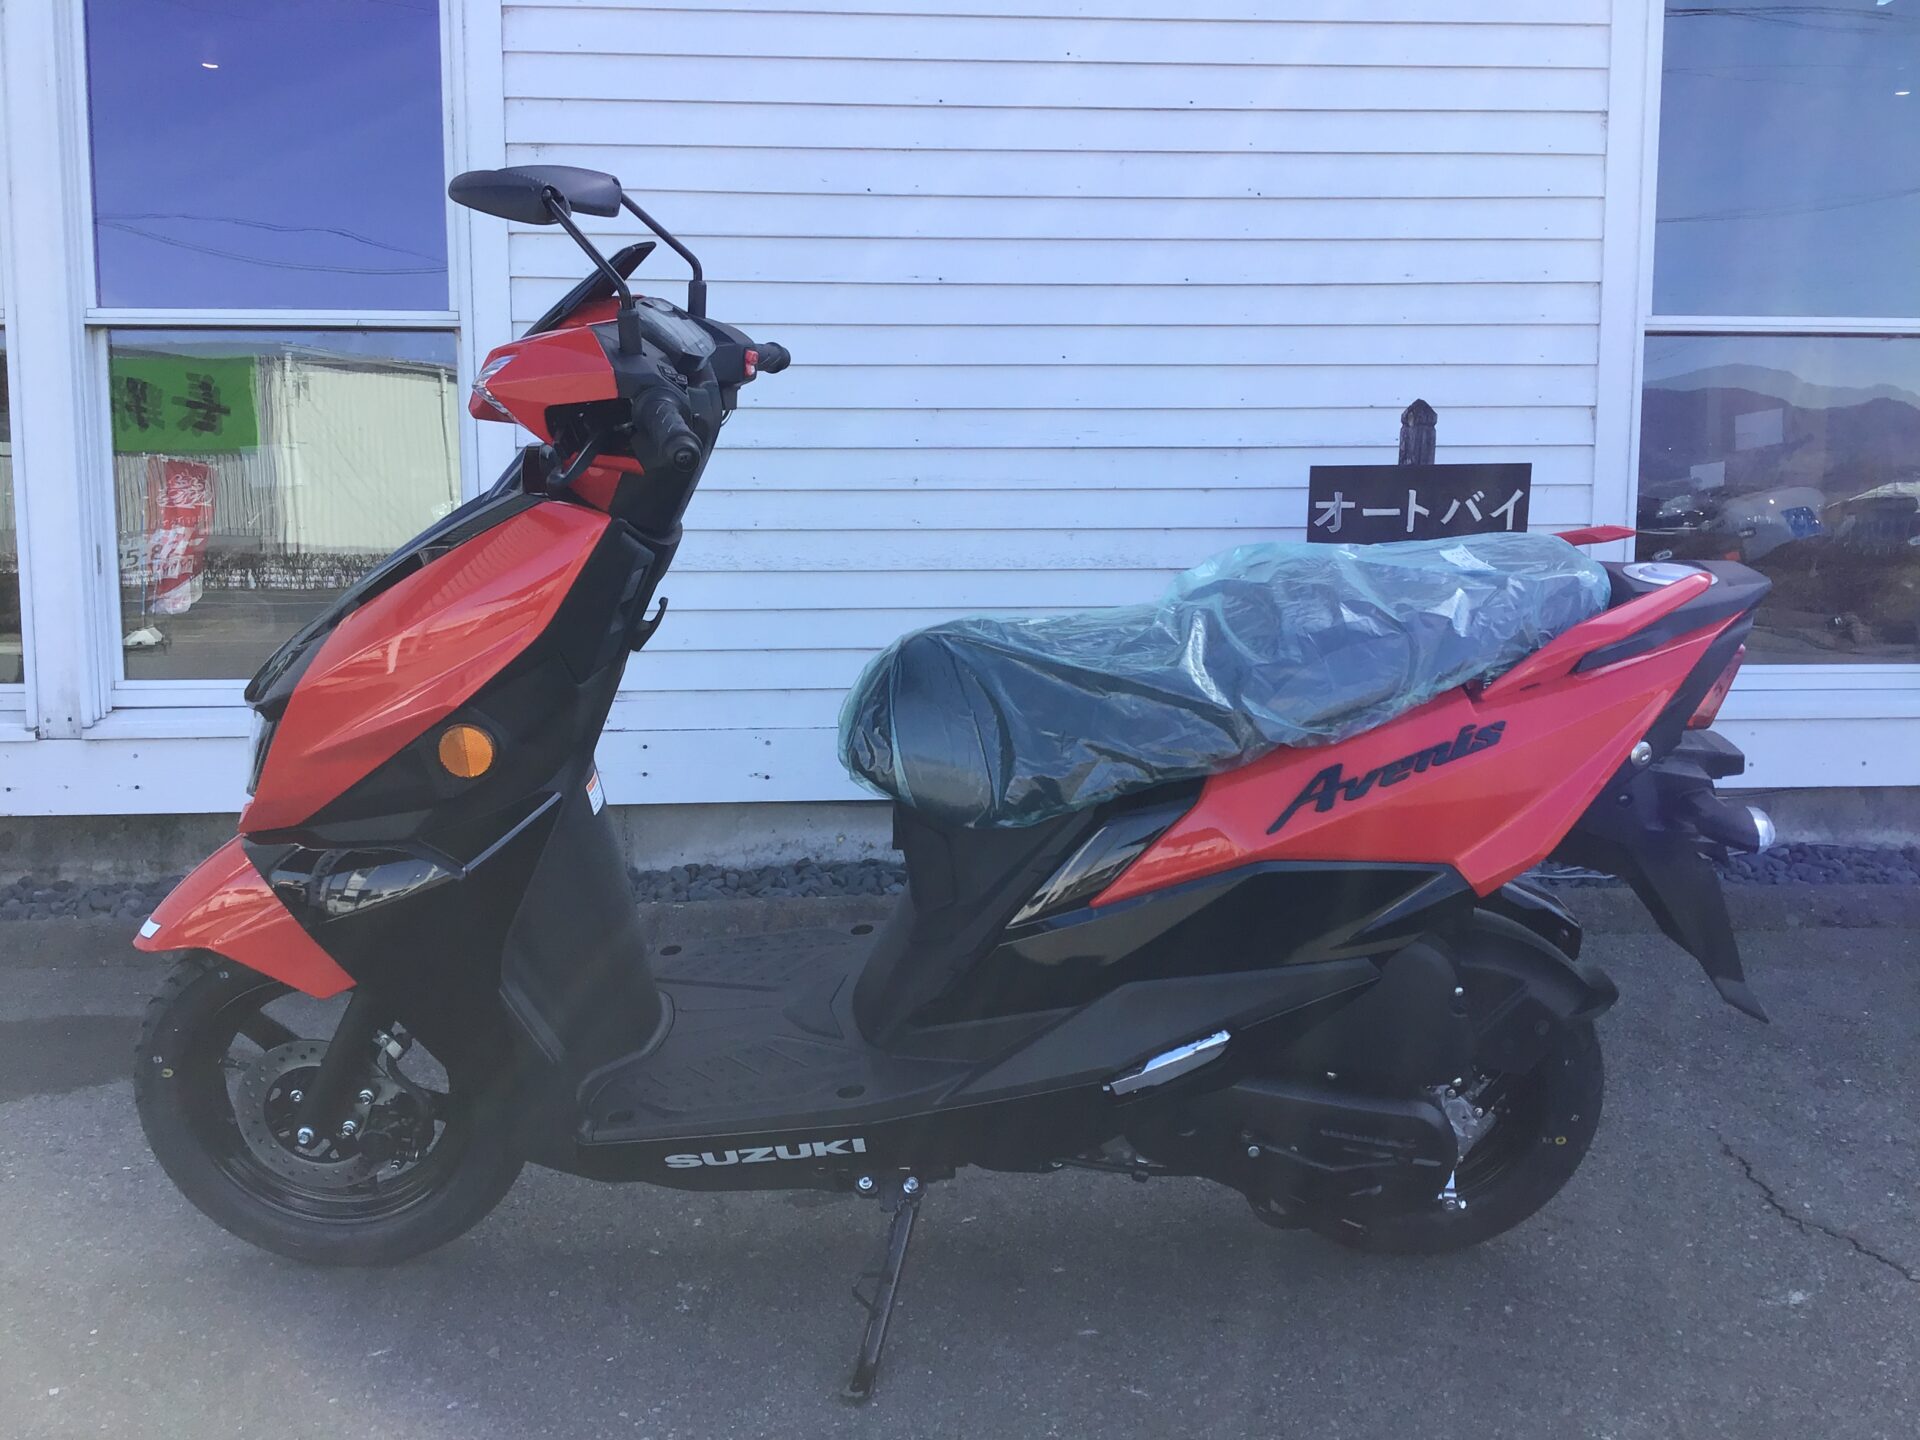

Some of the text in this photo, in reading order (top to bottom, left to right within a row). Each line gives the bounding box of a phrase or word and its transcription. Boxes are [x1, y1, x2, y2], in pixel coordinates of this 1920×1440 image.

[1314, 489, 1524, 533] オートバイ
[1266, 720, 1507, 835] Avenis
[664, 1138, 867, 1169] SUZUKI
